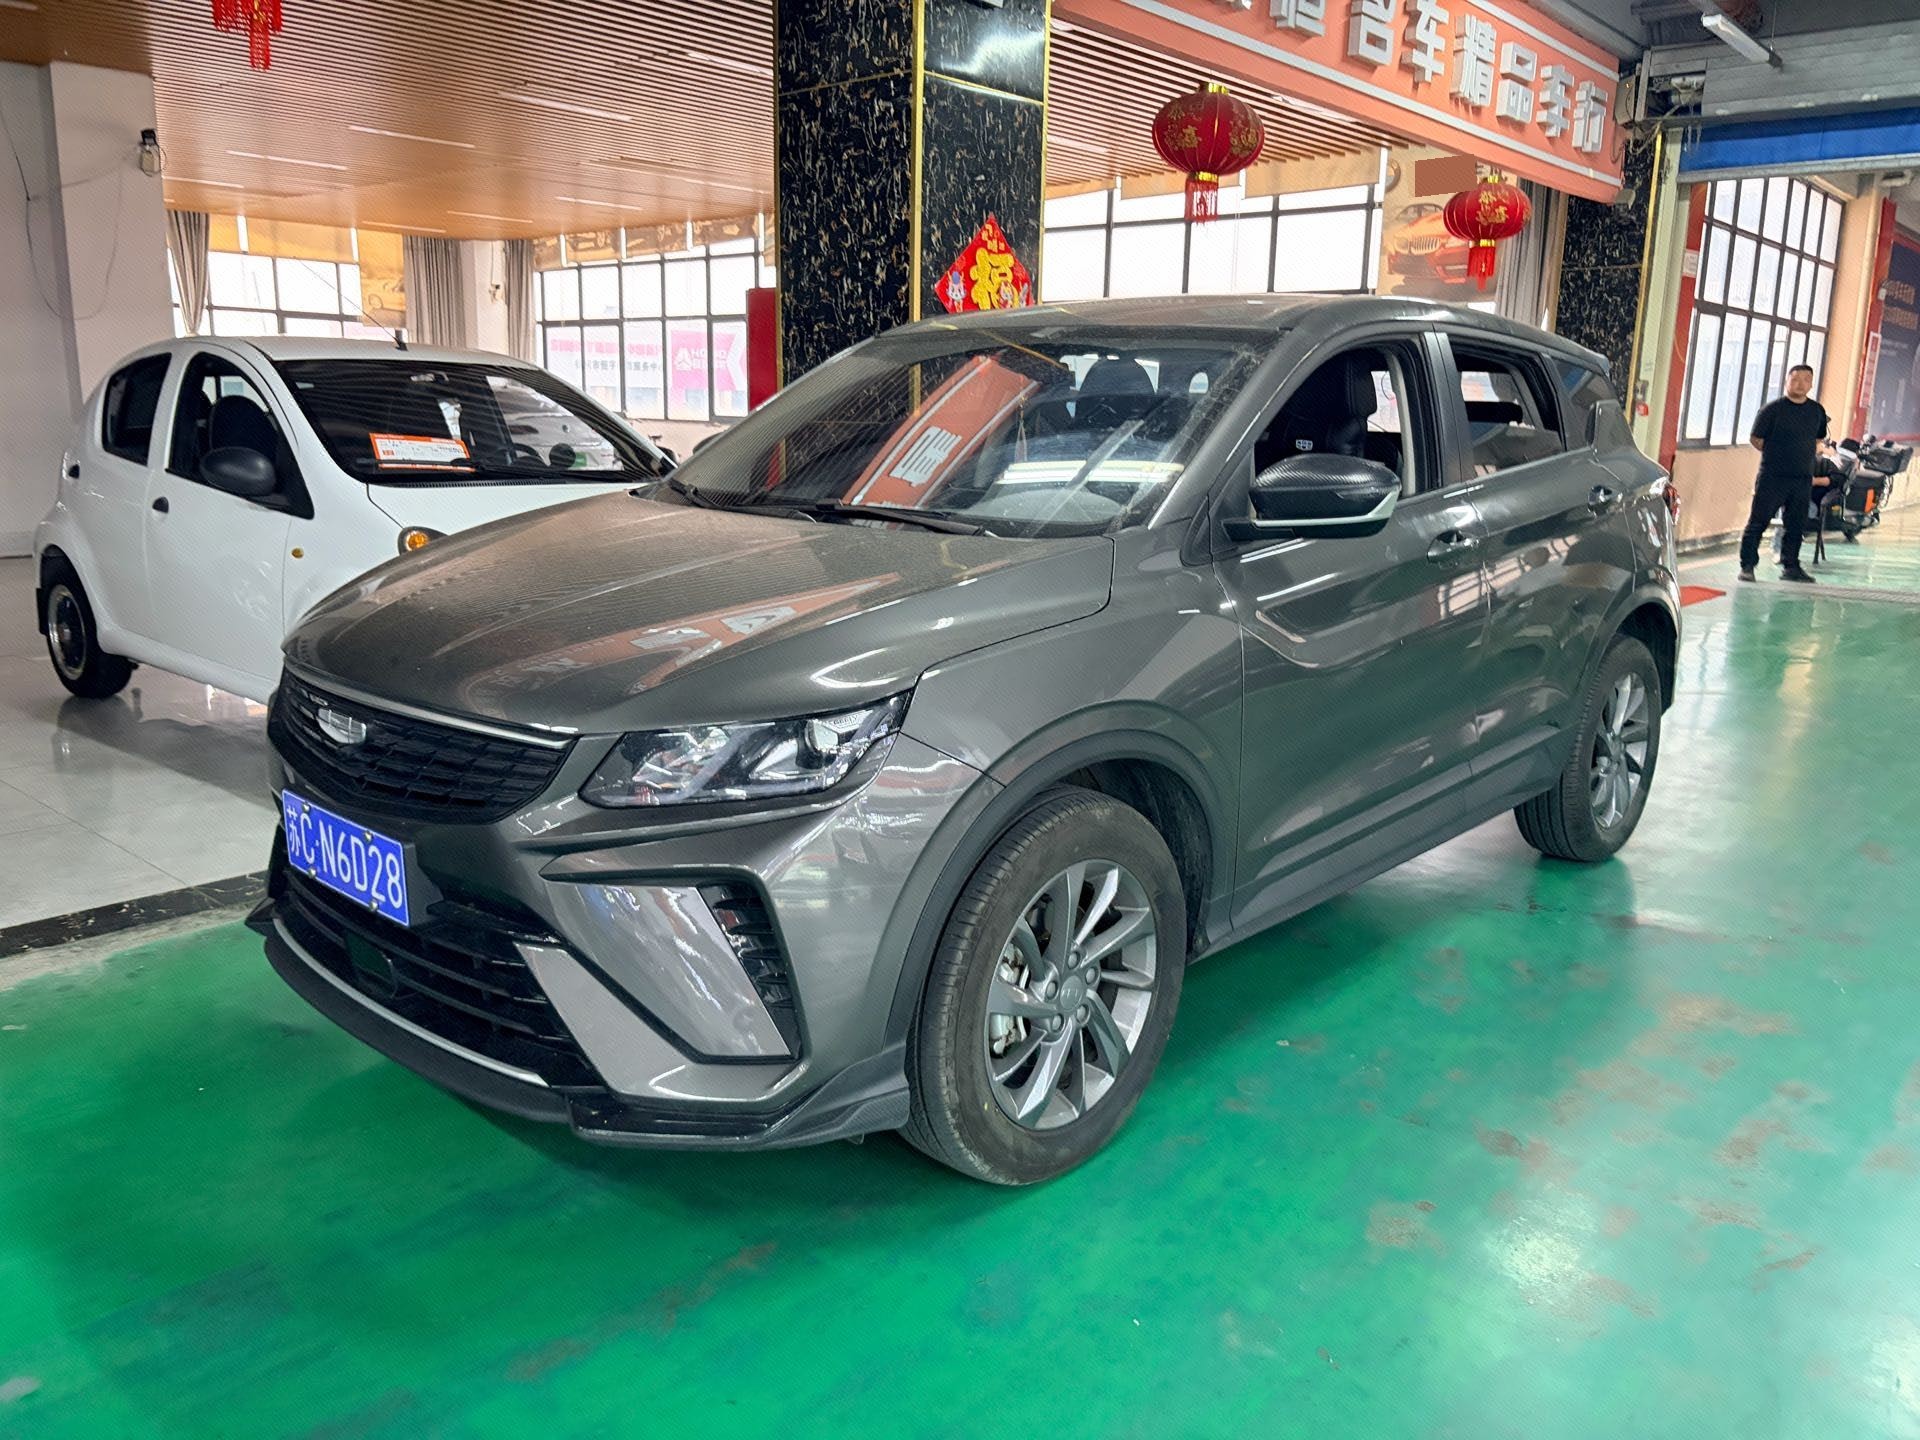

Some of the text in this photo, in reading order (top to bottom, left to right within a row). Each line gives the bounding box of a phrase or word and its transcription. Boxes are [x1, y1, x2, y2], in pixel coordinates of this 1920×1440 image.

[1228, 0, 1607, 153] 名车精品车行
